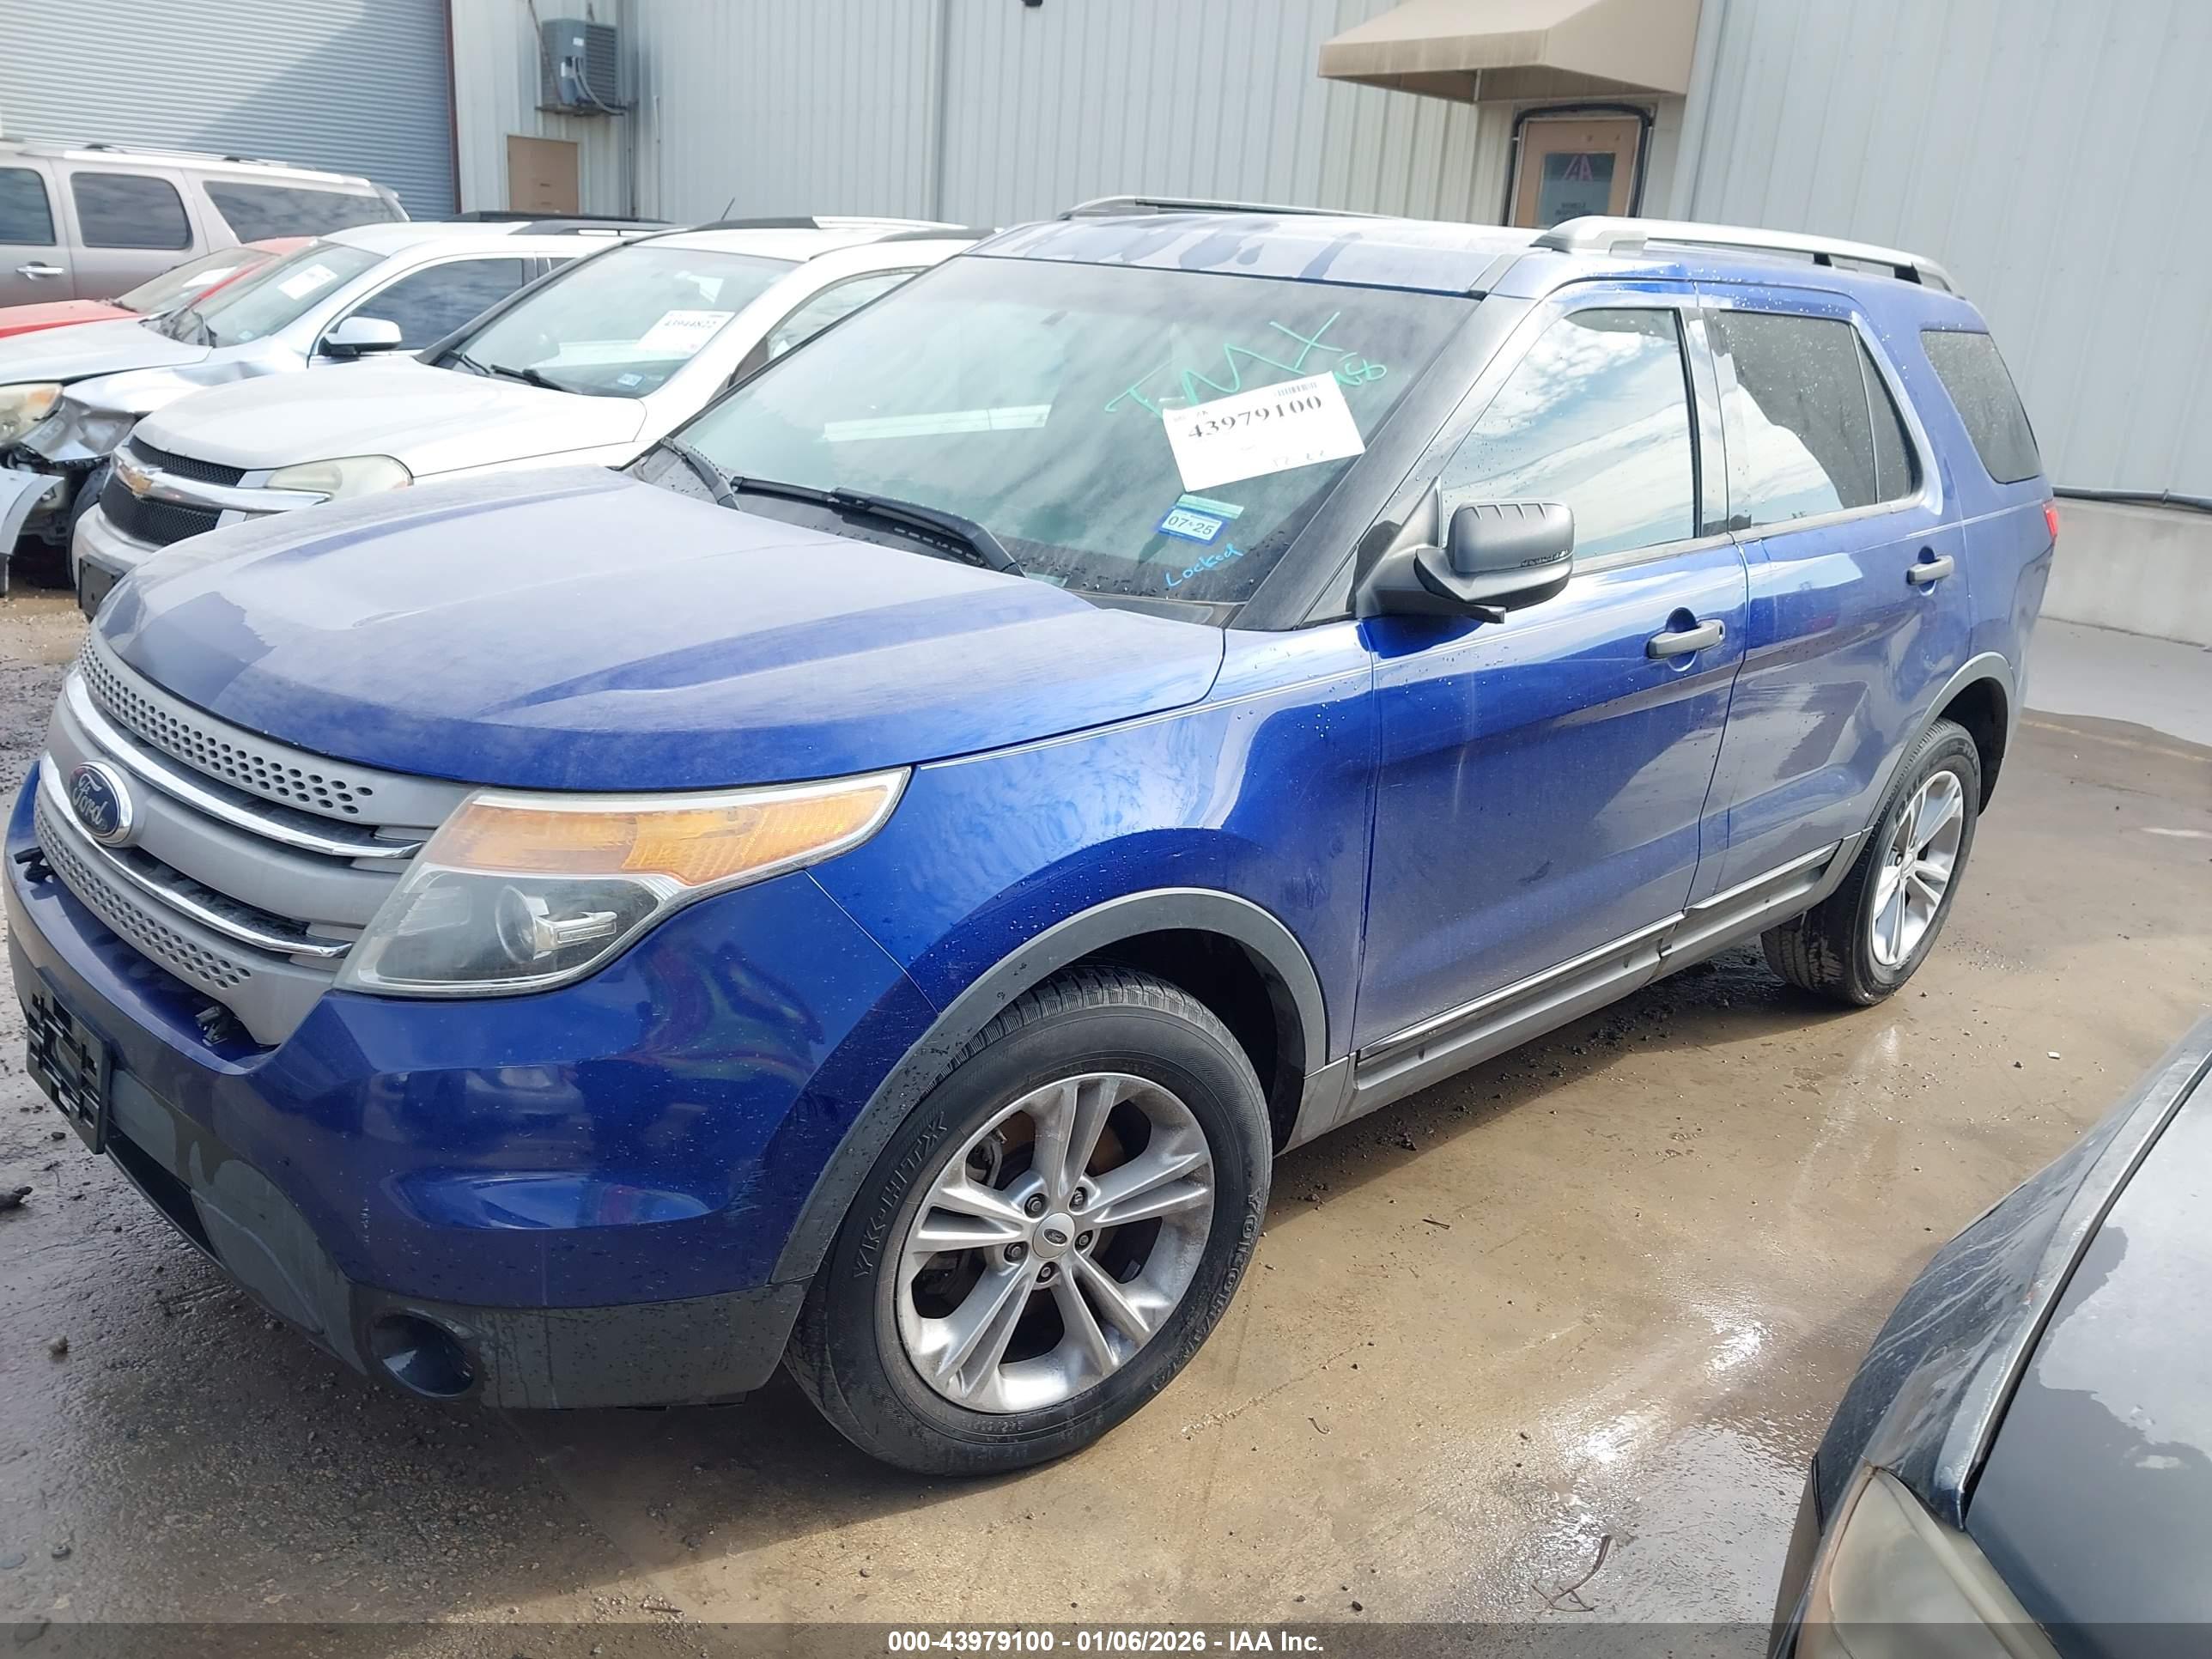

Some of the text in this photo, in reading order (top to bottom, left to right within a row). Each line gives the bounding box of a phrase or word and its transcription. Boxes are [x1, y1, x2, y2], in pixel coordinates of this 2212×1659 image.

[1188, 394, 1323, 439] 43979100
[1165, 543, 1244, 587] Locked
[71, 772, 109, 830] Ford
